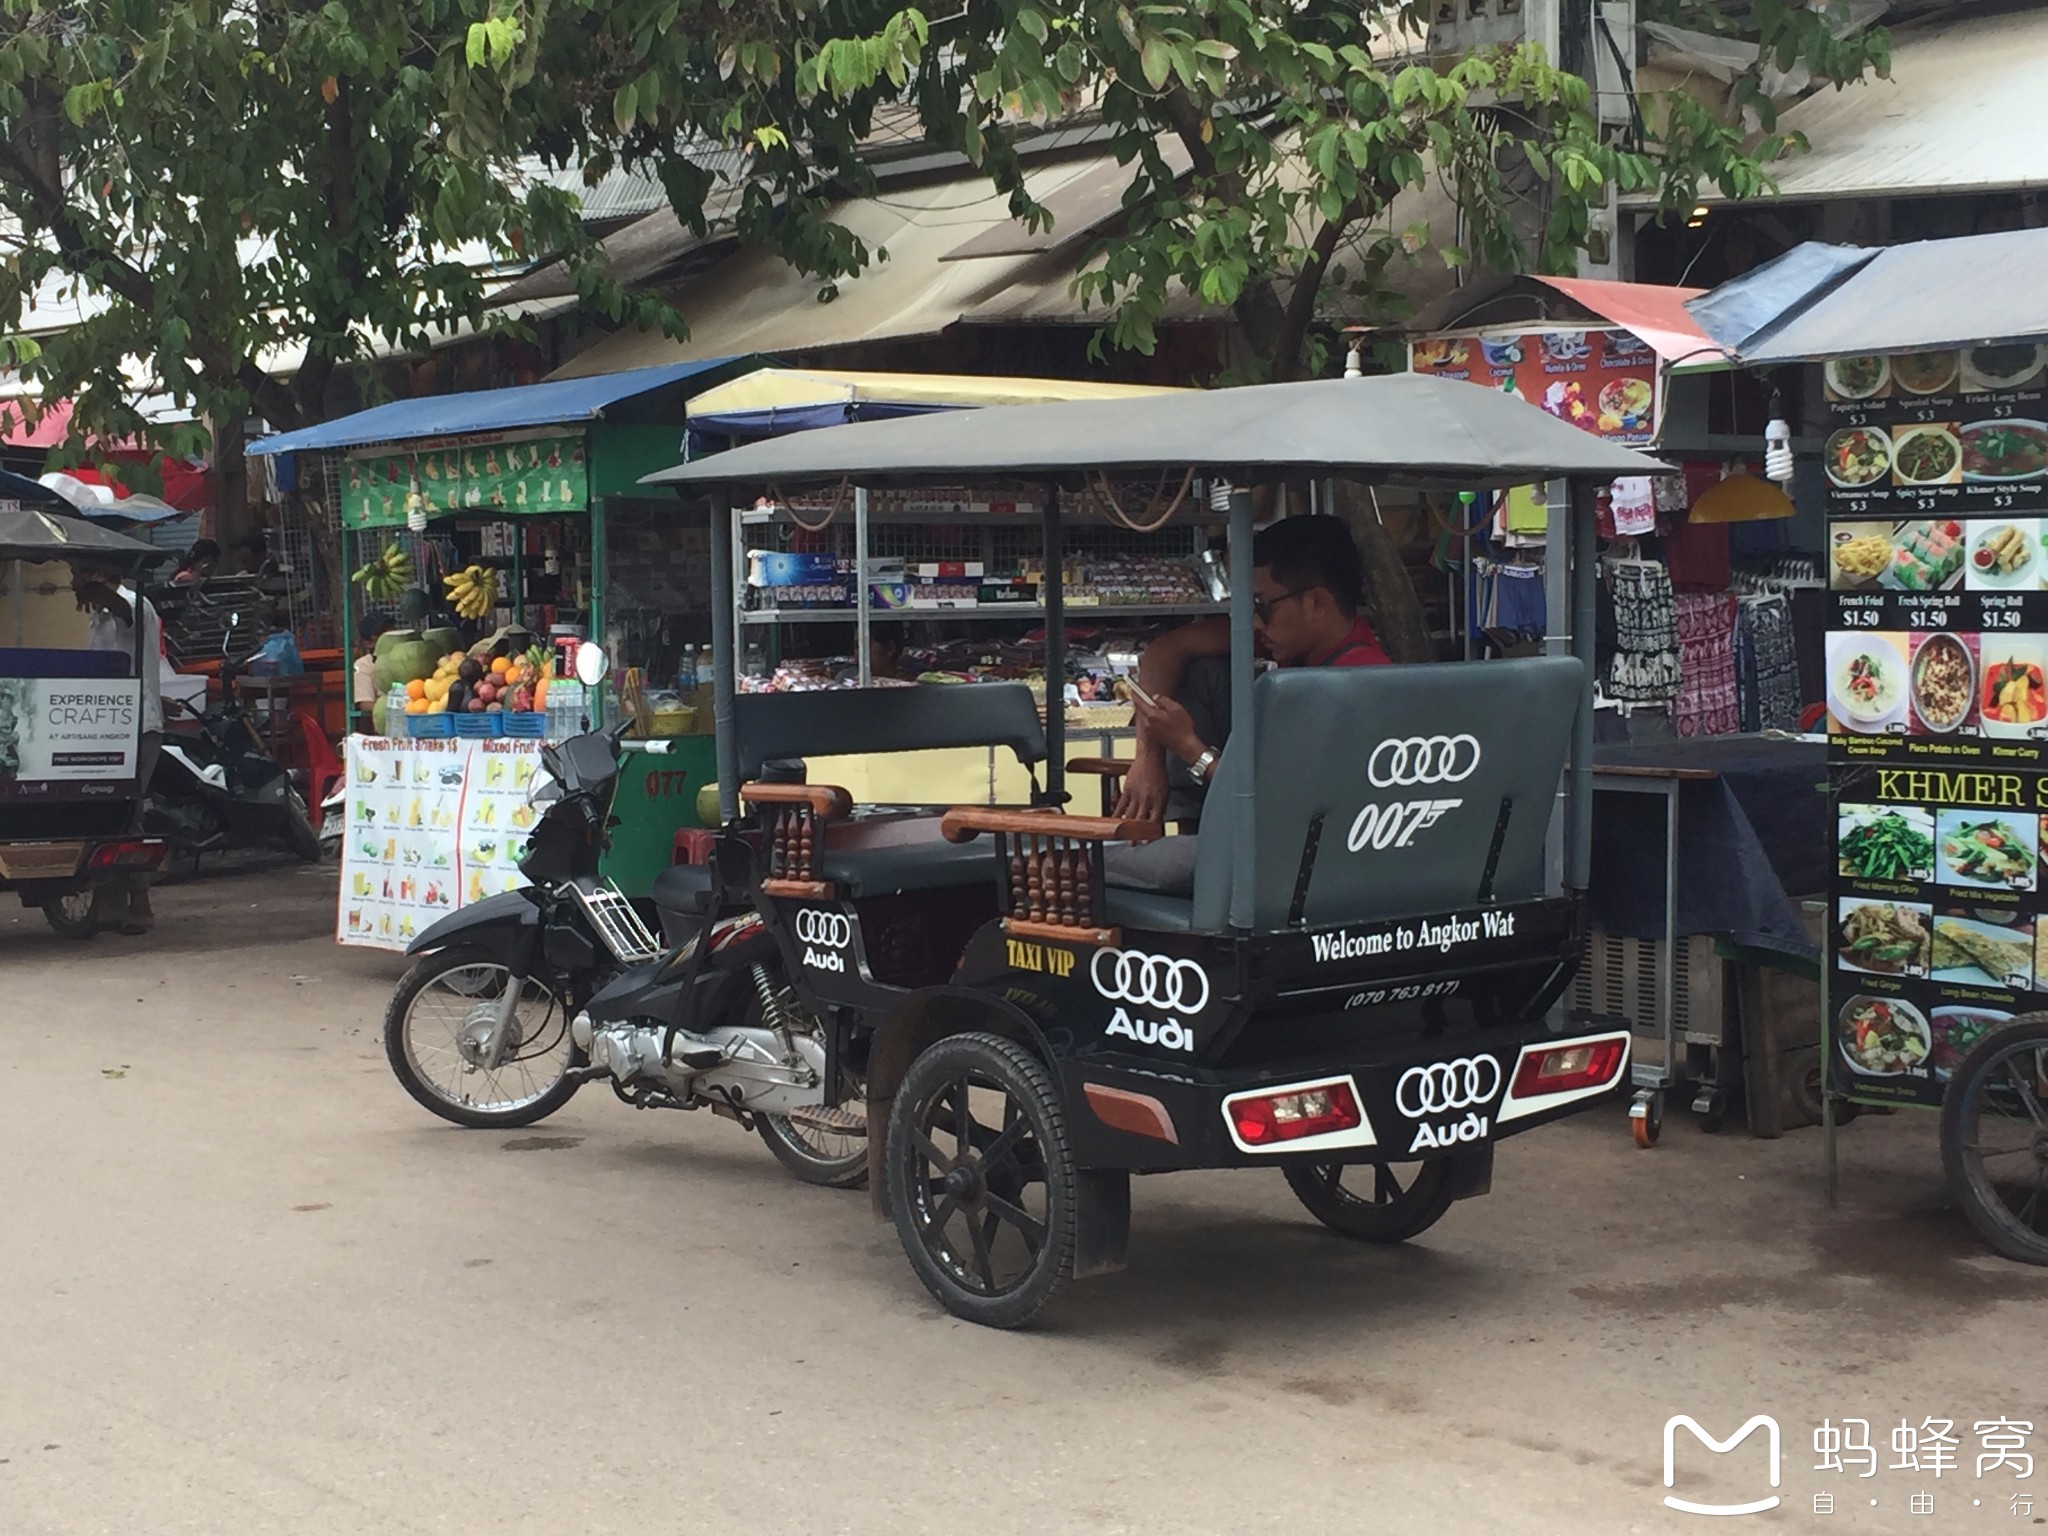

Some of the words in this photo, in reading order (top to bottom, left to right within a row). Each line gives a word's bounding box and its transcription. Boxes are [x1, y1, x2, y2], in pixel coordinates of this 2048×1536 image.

[1871, 490, 1890, 500] Soup
[1939, 487, 1959, 498] Soup
[1966, 486, 1995, 495] Khmer
[2019, 484, 2042, 494] Soup
[1839, 596, 1864, 606] French
[1898, 596, 1919, 606] Fresh
[1920, 596, 1944, 609] Spring
[1980, 596, 2006, 609] Spring
[1843, 611, 1879, 626] $1.50
[1910, 611, 1947, 627] $1.50
[1983, 612, 2021, 628] $1.50
[49, 694, 134, 706] EXPERIENCE
[48, 708, 133, 725] CRAFTS
[362, 738, 390, 751] Fresh
[392, 737, 413, 751] Fruit
[415, 737, 445, 752] Shake
[483, 738, 511, 753] Mixed
[513, 739, 536, 753] Fruit
[646, 769, 687, 799] 077
[1876, 770, 2026, 807] KHMER
[1348, 799, 1434, 852] 007
[1311, 929, 1393, 963] Welcome
[1396, 926, 1414, 950] to
[1416, 915, 1481, 953] Angkor
[1482, 911, 1515, 938] Wat
[802, 946, 845, 973] Audi
[1006, 939, 1043, 972] TAXI
[1046, 947, 1076, 978] VIP
[1344, 990, 1386, 1010] (070
[1388, 985, 1421, 1001] 763
[1422, 979, 1460, 997] 817)
[1104, 1006, 1194, 1052] Audi
[1408, 1112, 1489, 1153] Audi
